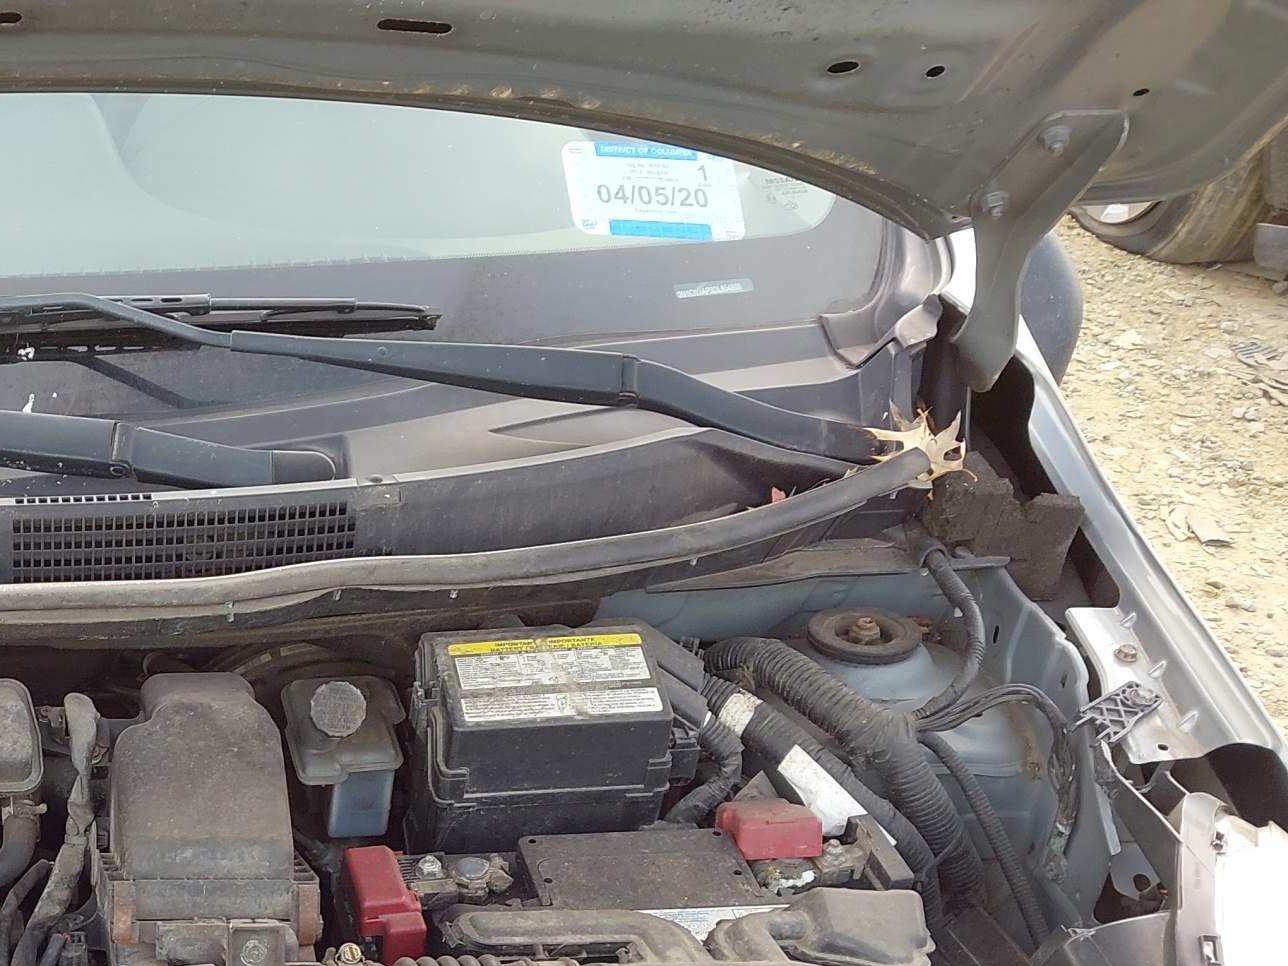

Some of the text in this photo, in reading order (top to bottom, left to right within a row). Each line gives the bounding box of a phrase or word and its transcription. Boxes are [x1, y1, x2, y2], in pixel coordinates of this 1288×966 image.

[600, 144, 636, 154] DISTRICT
[698, 164, 708, 182] 1
[597, 184, 708, 208] 04/05/20
